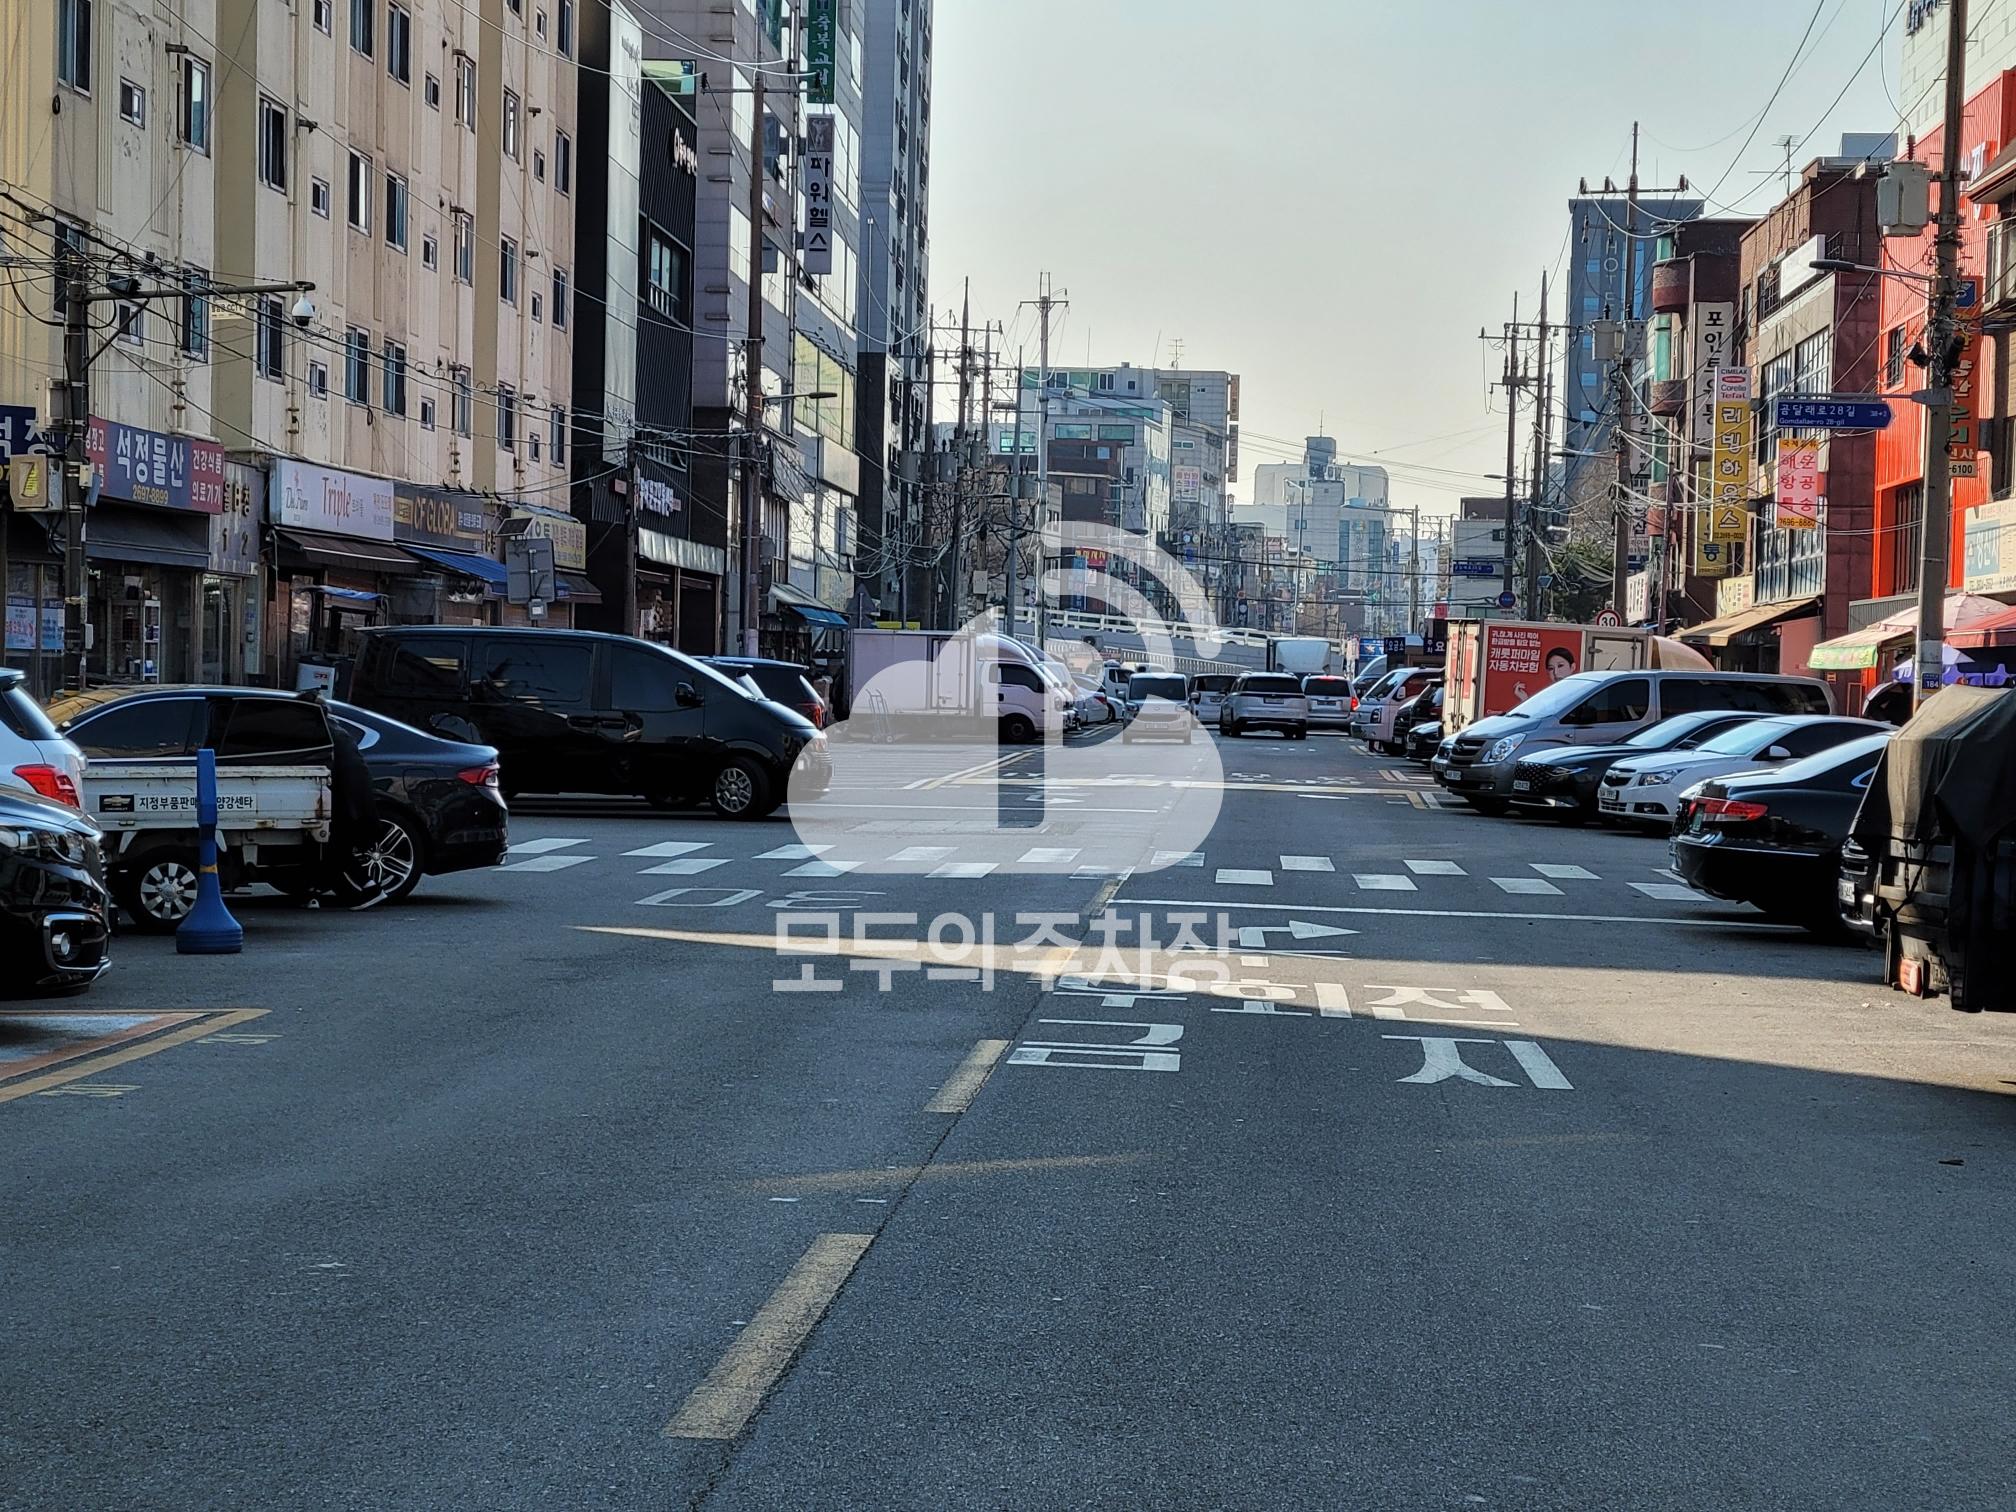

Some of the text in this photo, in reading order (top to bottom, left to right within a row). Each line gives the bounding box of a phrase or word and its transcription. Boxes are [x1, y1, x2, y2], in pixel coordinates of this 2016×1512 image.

[809, 157, 830, 252] 파워헬스
[116, 428, 184, 489] 석정물산
[192, 449, 222, 475] 건강식품
[1718, 406, 1743, 529] 리빙하우스
[1781, 455, 1815, 469] 해운
[1780, 474, 1815, 490] 항공
[132, 483, 169, 505] 2697-8899
[191, 482, 221, 506] 의료기기
[322, 476, 352, 528] Triple
[1601, 616, 1616, 626] 30
[1514, 631, 1526, 639] 사진
[1490, 647, 1540, 661] 캐롯퍼마일
[1488, 660, 1540, 674] 자동차보험
[1926, 680, 1939, 688] 184
